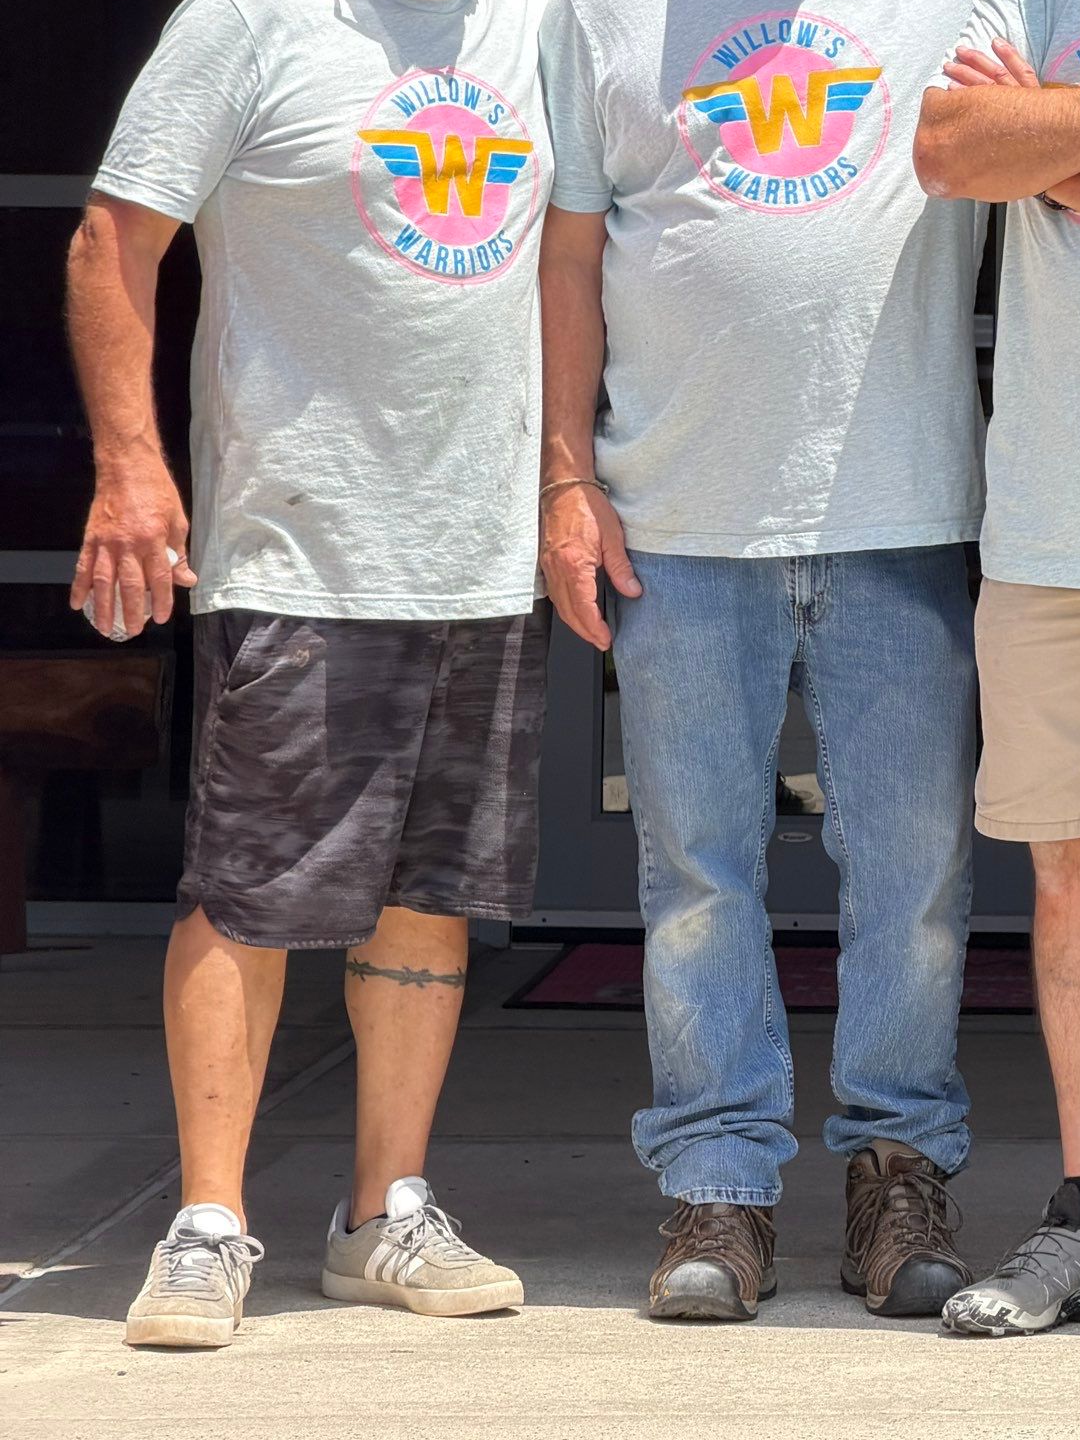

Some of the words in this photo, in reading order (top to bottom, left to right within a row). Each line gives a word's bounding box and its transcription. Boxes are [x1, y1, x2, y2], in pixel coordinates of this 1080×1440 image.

[712, 19, 845, 70] WILLOW'S
[391, 77, 504, 125] WILLOW'S
[723, 157, 858, 204] WARRIORS
[393, 224, 513, 275] WARRIORS
